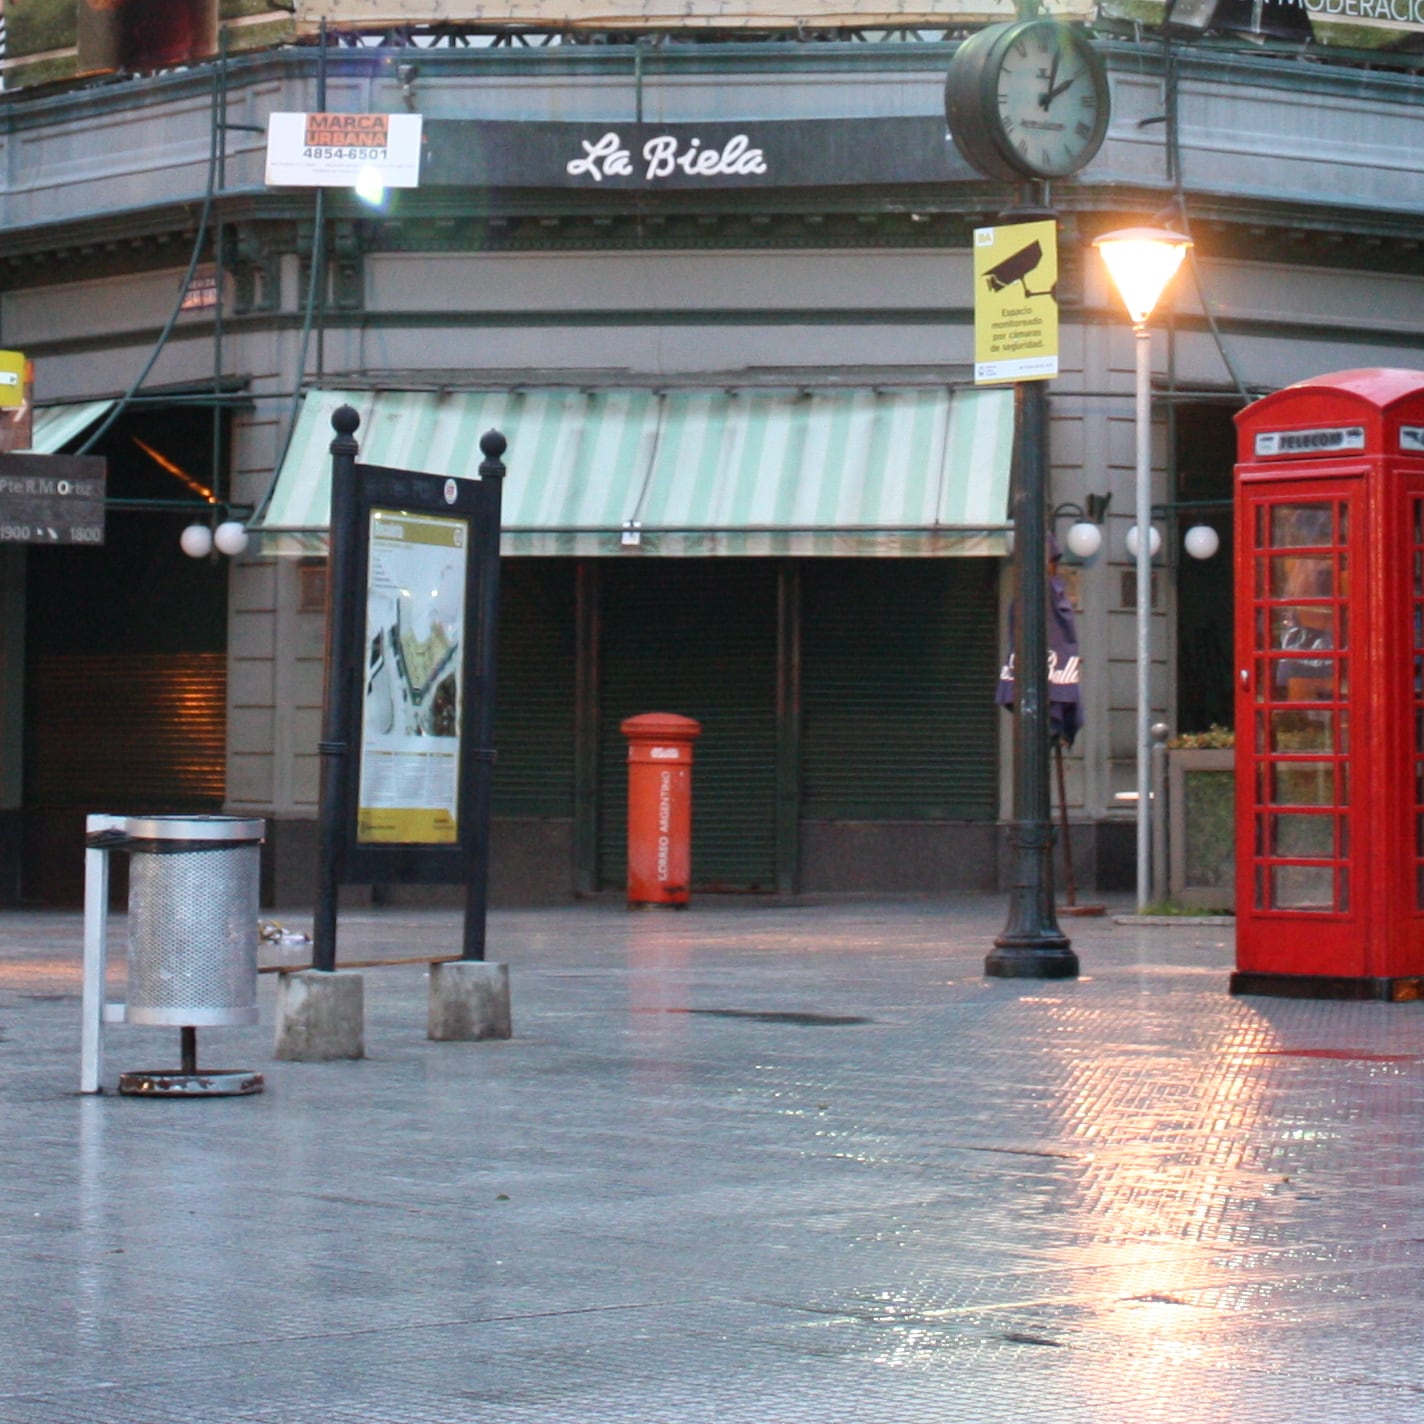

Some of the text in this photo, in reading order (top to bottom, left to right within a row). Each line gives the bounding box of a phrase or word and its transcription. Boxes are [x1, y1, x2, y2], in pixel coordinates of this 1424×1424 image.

[309, 116, 385, 130] MARCA
[306, 130, 387, 147] URBANA
[303, 147, 389, 161] 4854-6501
[566, 132, 768, 183] La Biela
[1001, 307, 1033, 318] Espacio
[992, 333, 1006, 343] por
[990, 343, 1000, 353] de
[1280, 431, 1344, 449] TELECOM
[0, 526, 101, 542] 1900 1800
